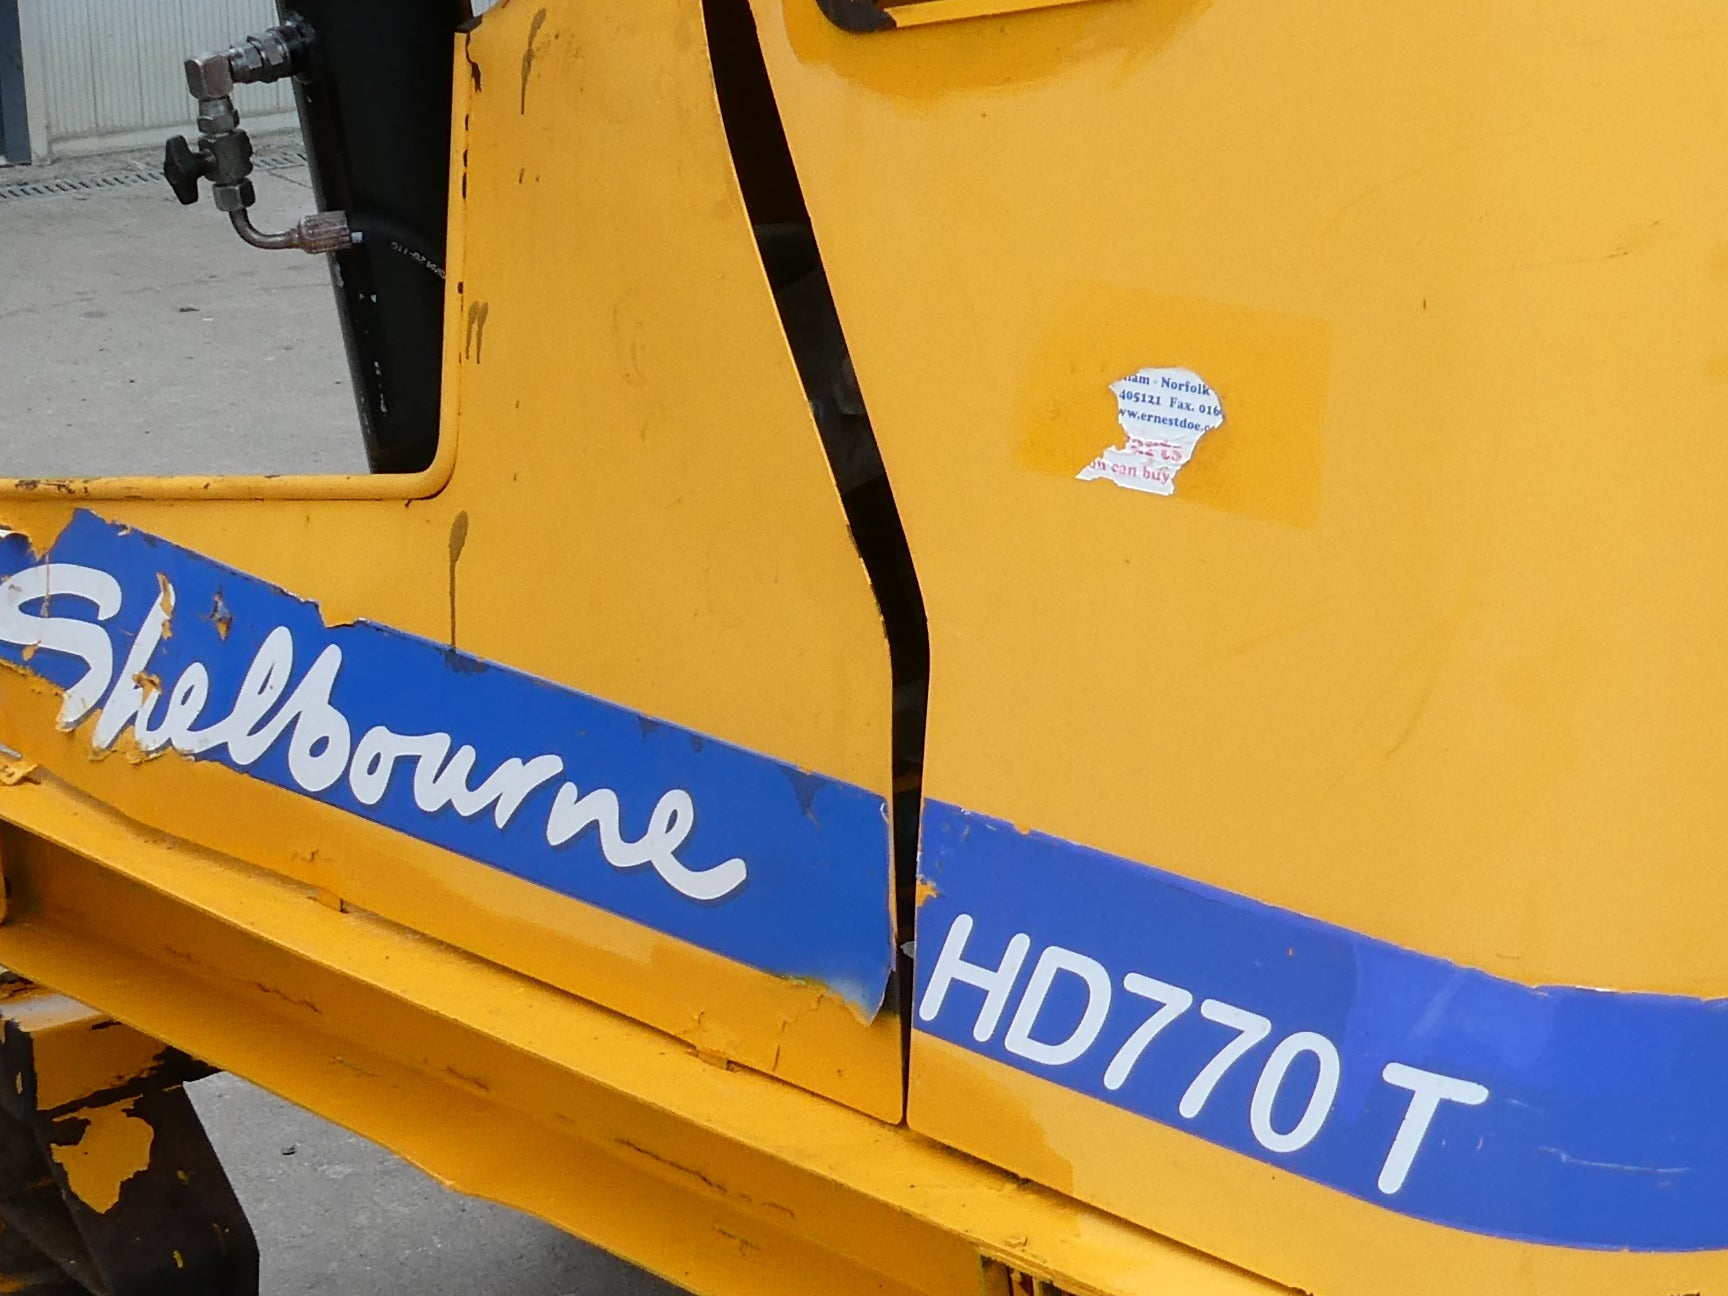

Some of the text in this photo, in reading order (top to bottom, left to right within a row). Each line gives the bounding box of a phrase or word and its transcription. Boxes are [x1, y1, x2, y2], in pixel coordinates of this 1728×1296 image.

[1161, 376, 1210, 396] Norfolk
[1119, 389, 1223, 416] 405121 Fax. 016
[1112, 463, 1137, 478] can
[1143, 466, 1170, 484] buy
[918, 913, 1490, 1195] HD770 T
